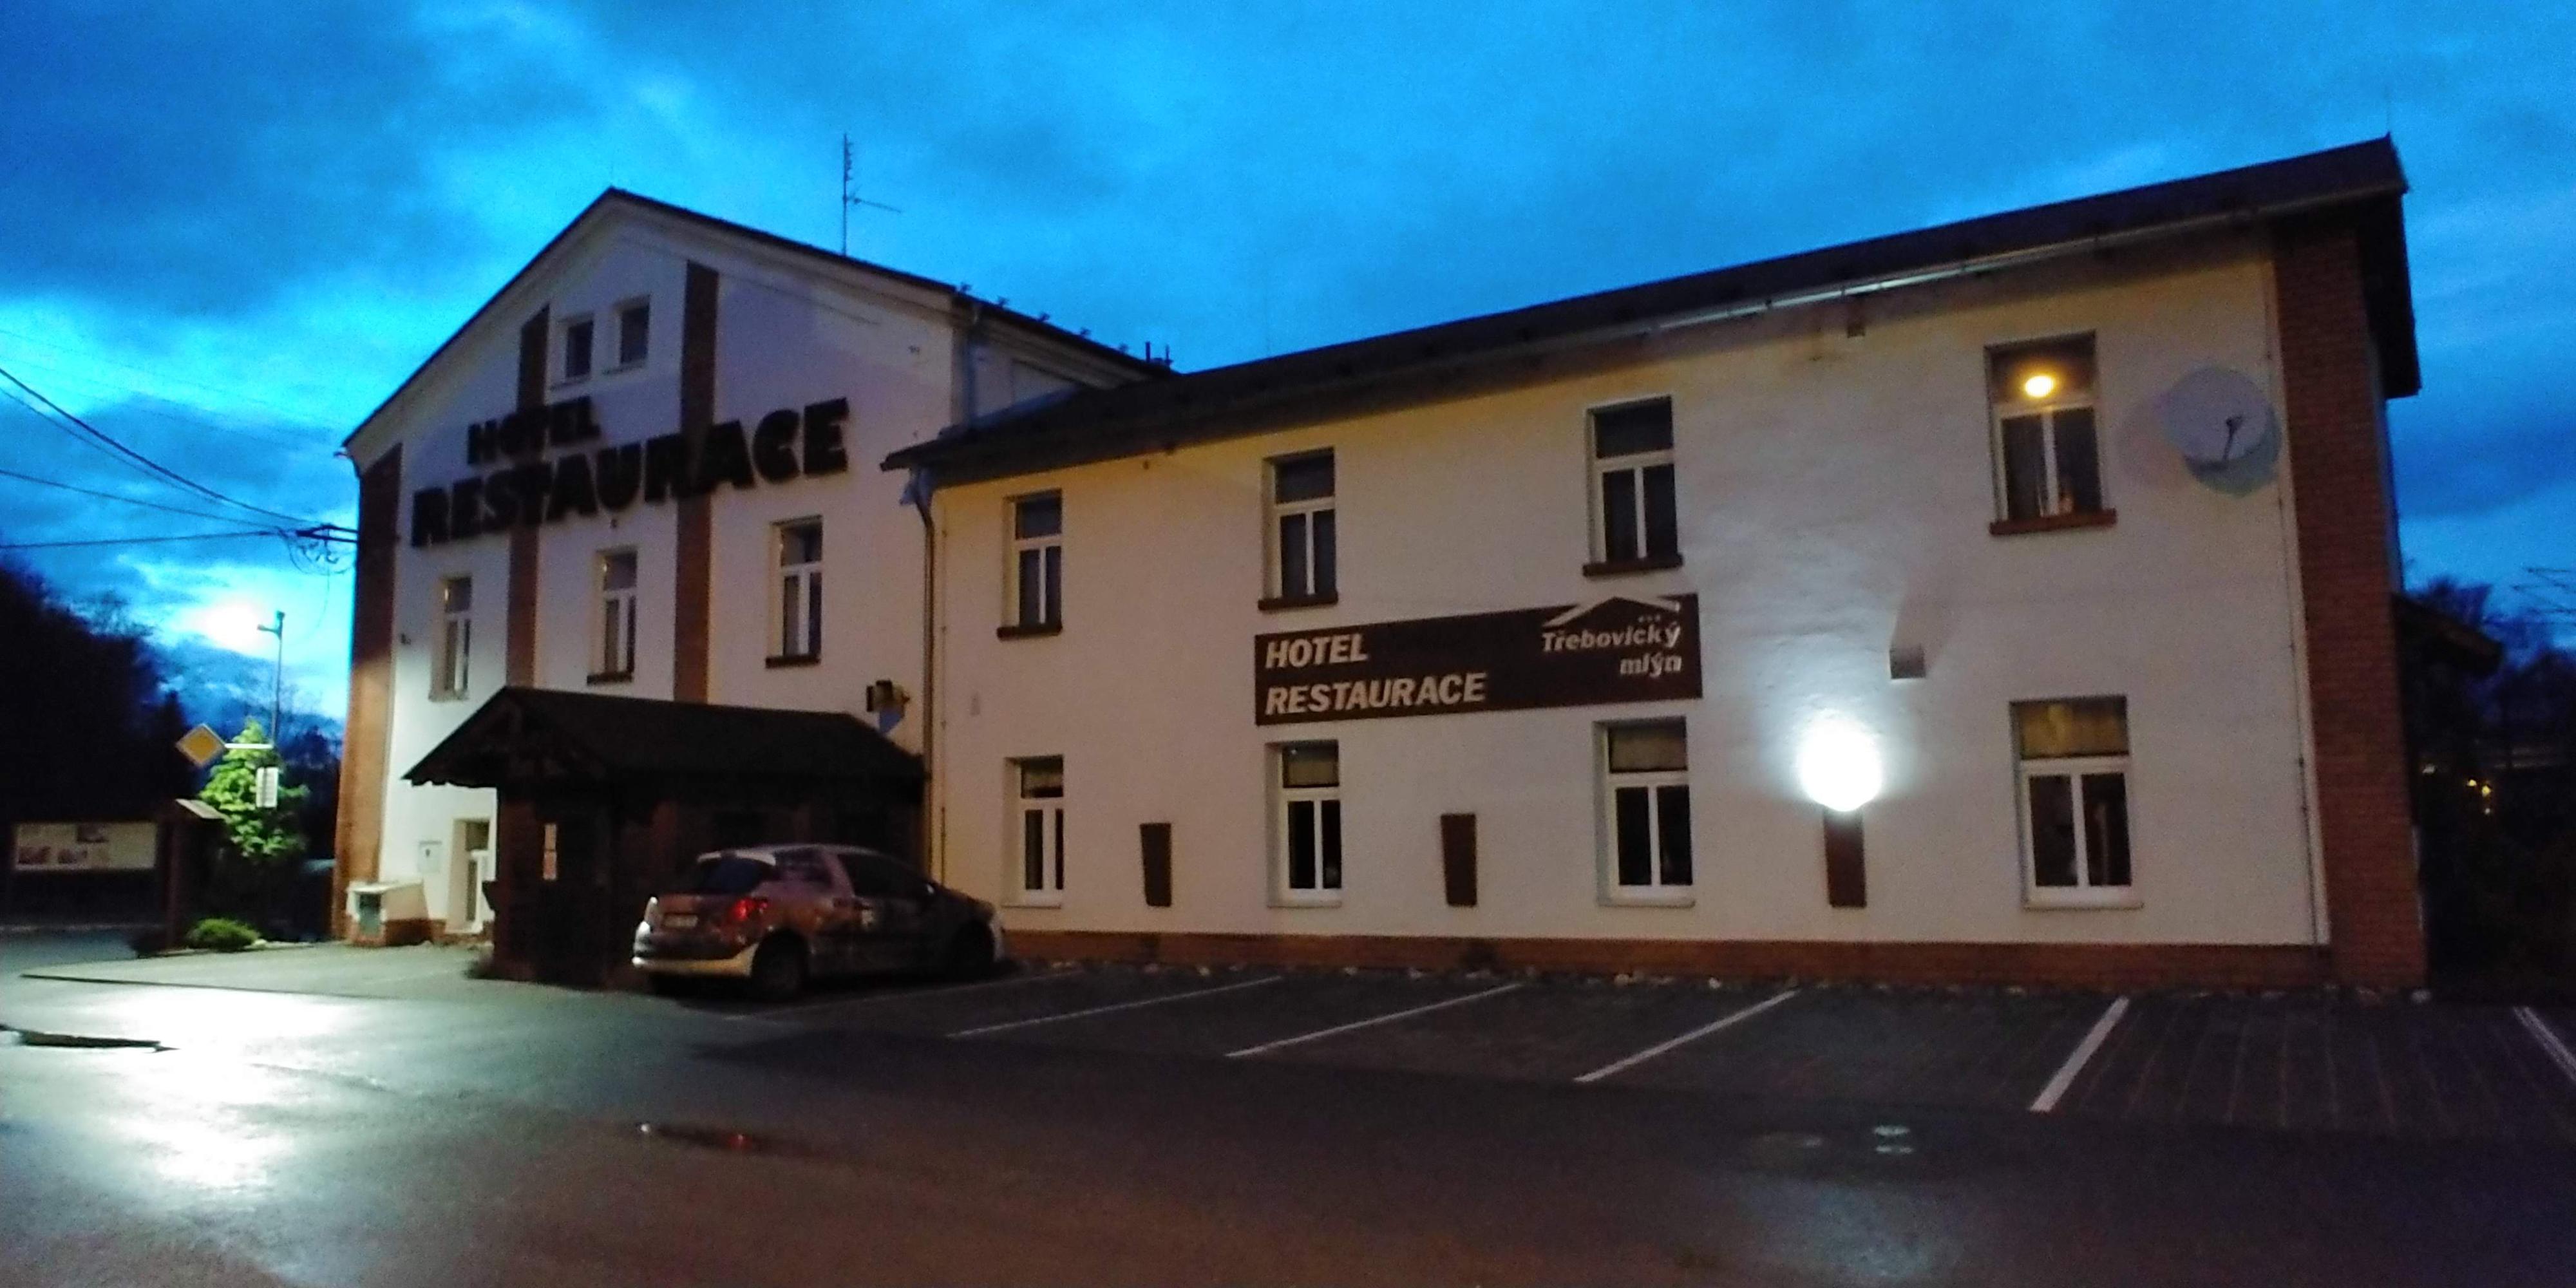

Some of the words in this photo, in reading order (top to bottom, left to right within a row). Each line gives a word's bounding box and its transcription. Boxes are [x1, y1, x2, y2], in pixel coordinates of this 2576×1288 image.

[466, 397, 600, 465] HOTEL
[412, 398, 849, 547] RESTAURACE
[1265, 633, 1368, 668] HOTEL
[1542, 620, 1681, 652] Třebovický
[1619, 652, 1683, 677] mlýn
[1265, 673, 1487, 715] RESTAURACE
